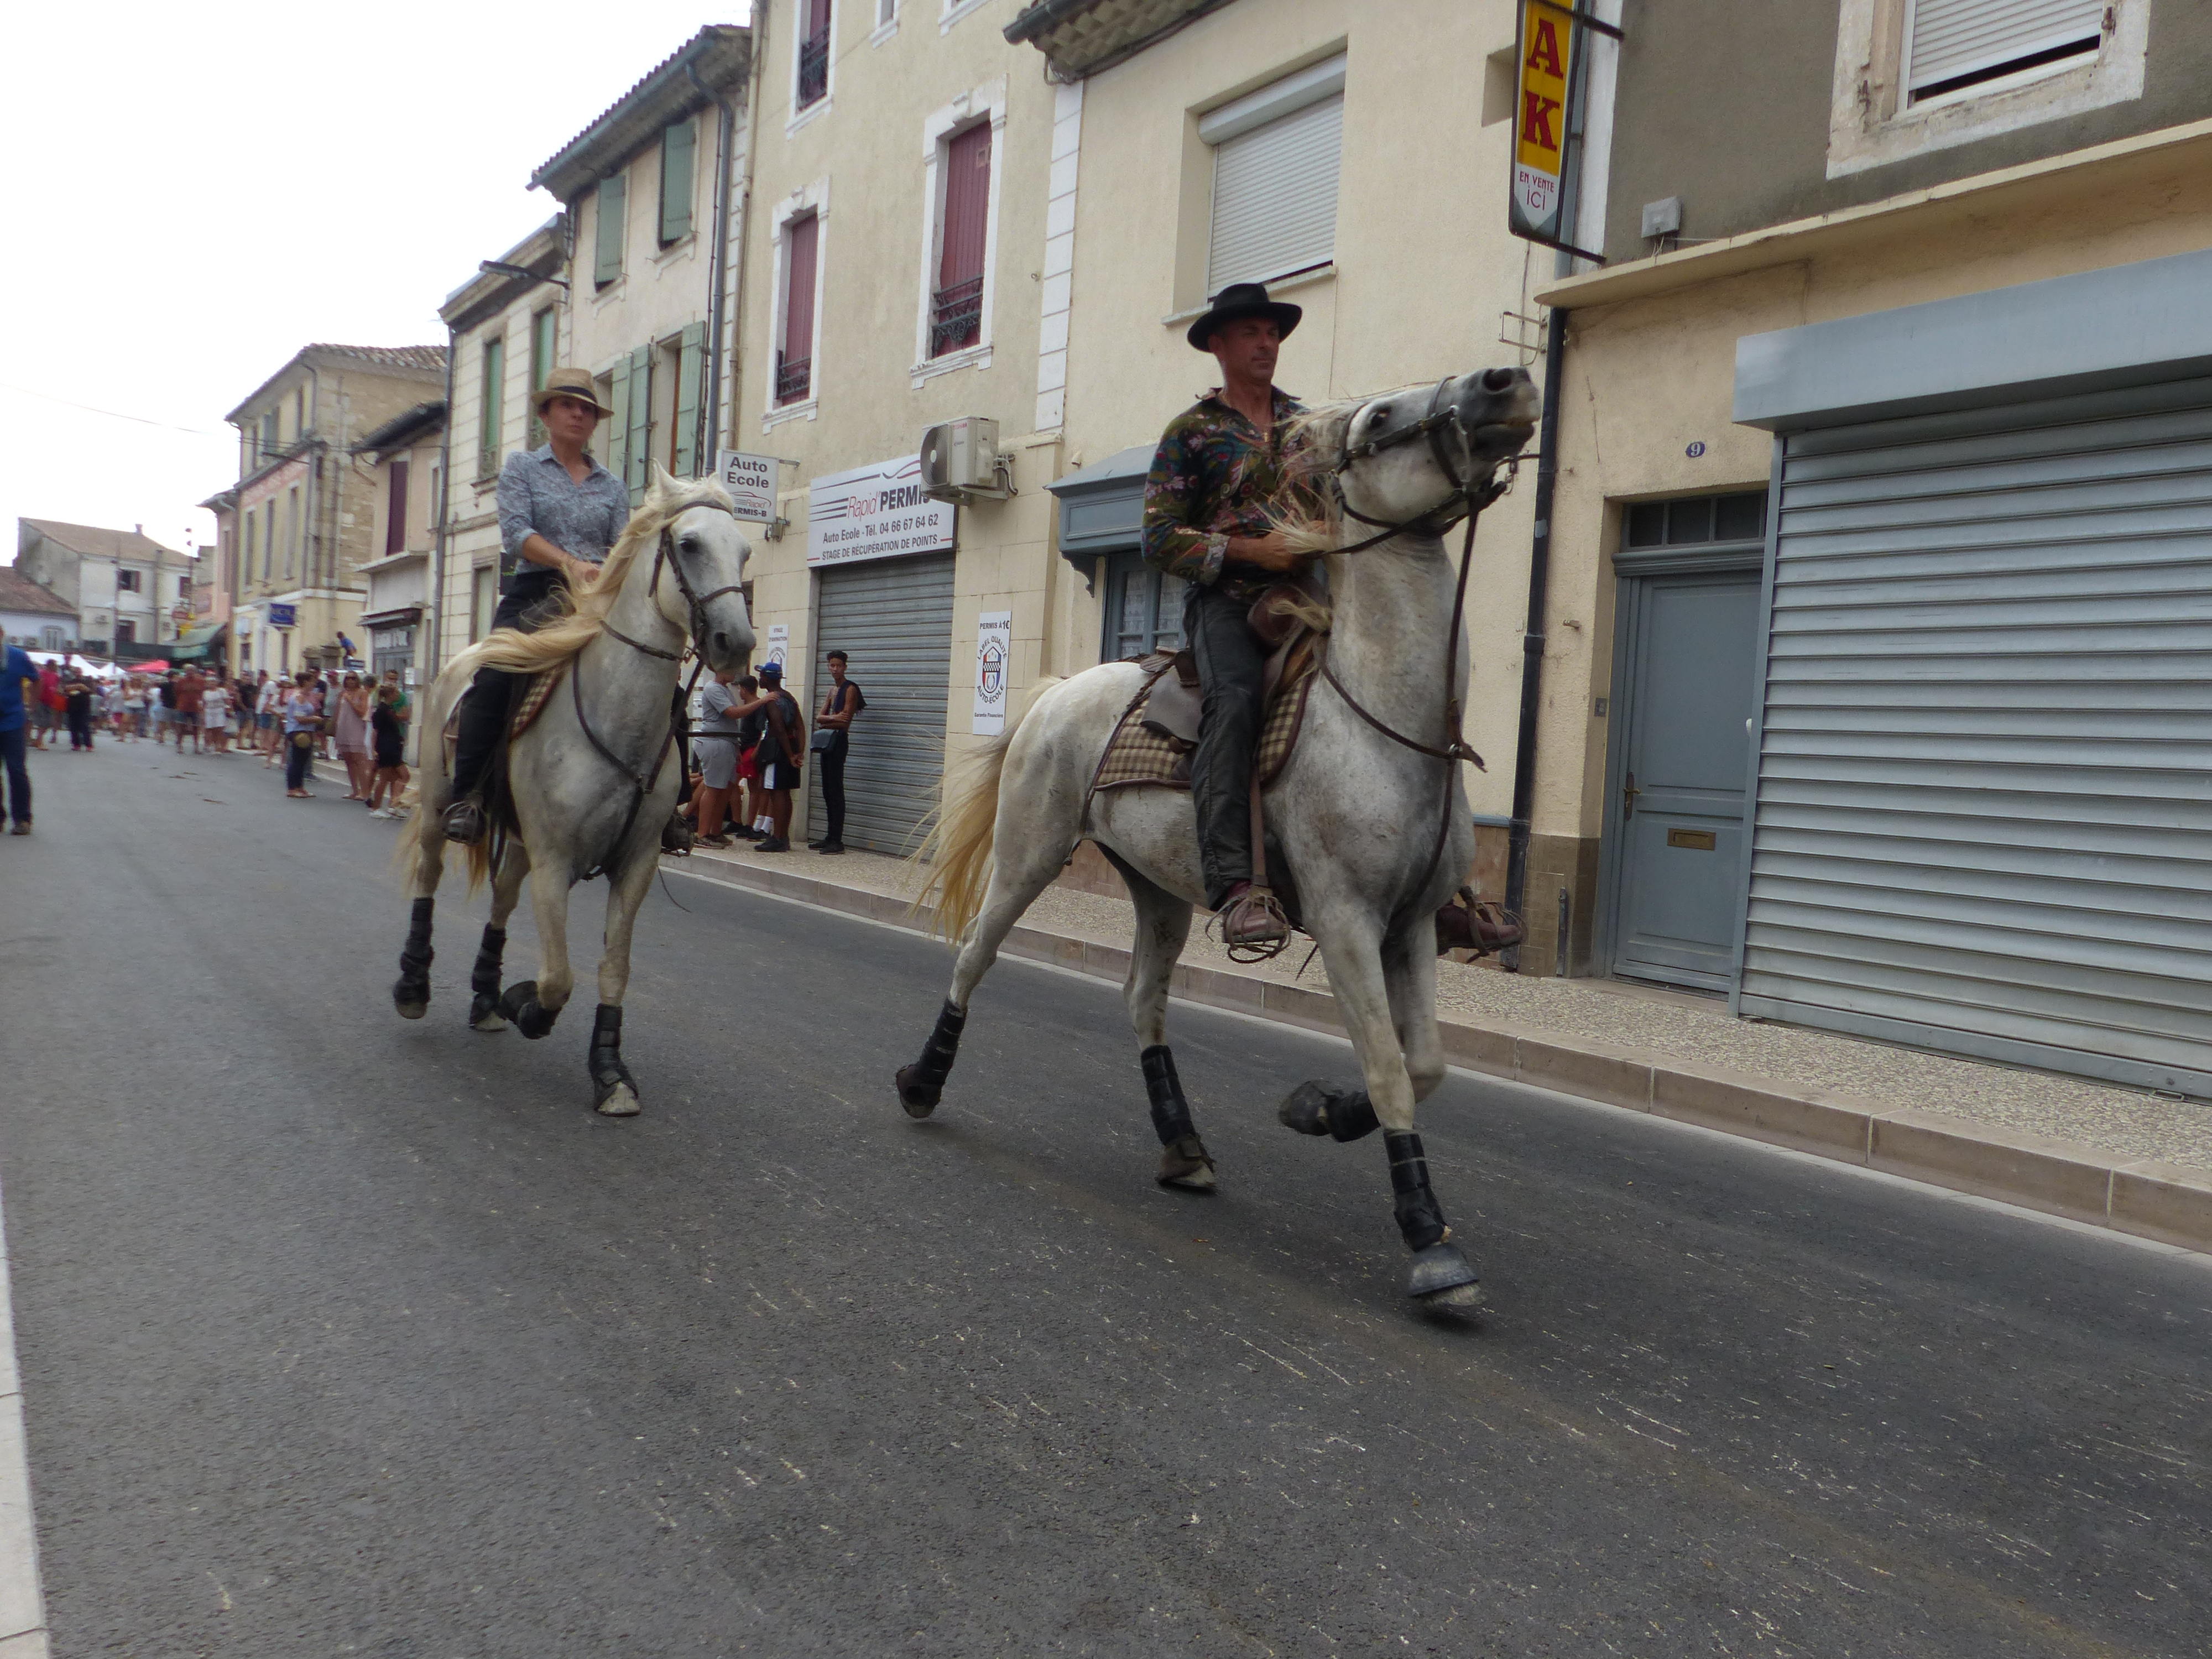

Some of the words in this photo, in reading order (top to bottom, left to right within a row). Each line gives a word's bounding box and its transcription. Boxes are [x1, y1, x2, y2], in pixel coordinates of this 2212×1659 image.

[1520, 171, 1530, 184] EN
[1532, 175, 1554, 193] VENTE
[1691, 442, 1701, 456] 9
[730, 456, 768, 472] Auto
[727, 472, 769, 488] Ecole
[733, 507, 767, 517] ERMIS-B
[823, 533, 839, 544] Auto
[841, 527, 860, 540] Ecole
[865, 524, 877, 536] Tél.
[880, 523, 889, 534] 04
[891, 520, 901, 533] 66
[903, 518, 913, 531] 67
[916, 515, 925, 529] 64
[928, 513, 938, 526] 62
[822, 549, 841, 560] STAGE
[842, 547, 850, 557] DE
[852, 540, 899, 556] RÉCUPÉRATION
[901, 539, 910, 549] DE
[912, 534, 937, 547] POINTS
[977, 638, 990, 660] LABEL
